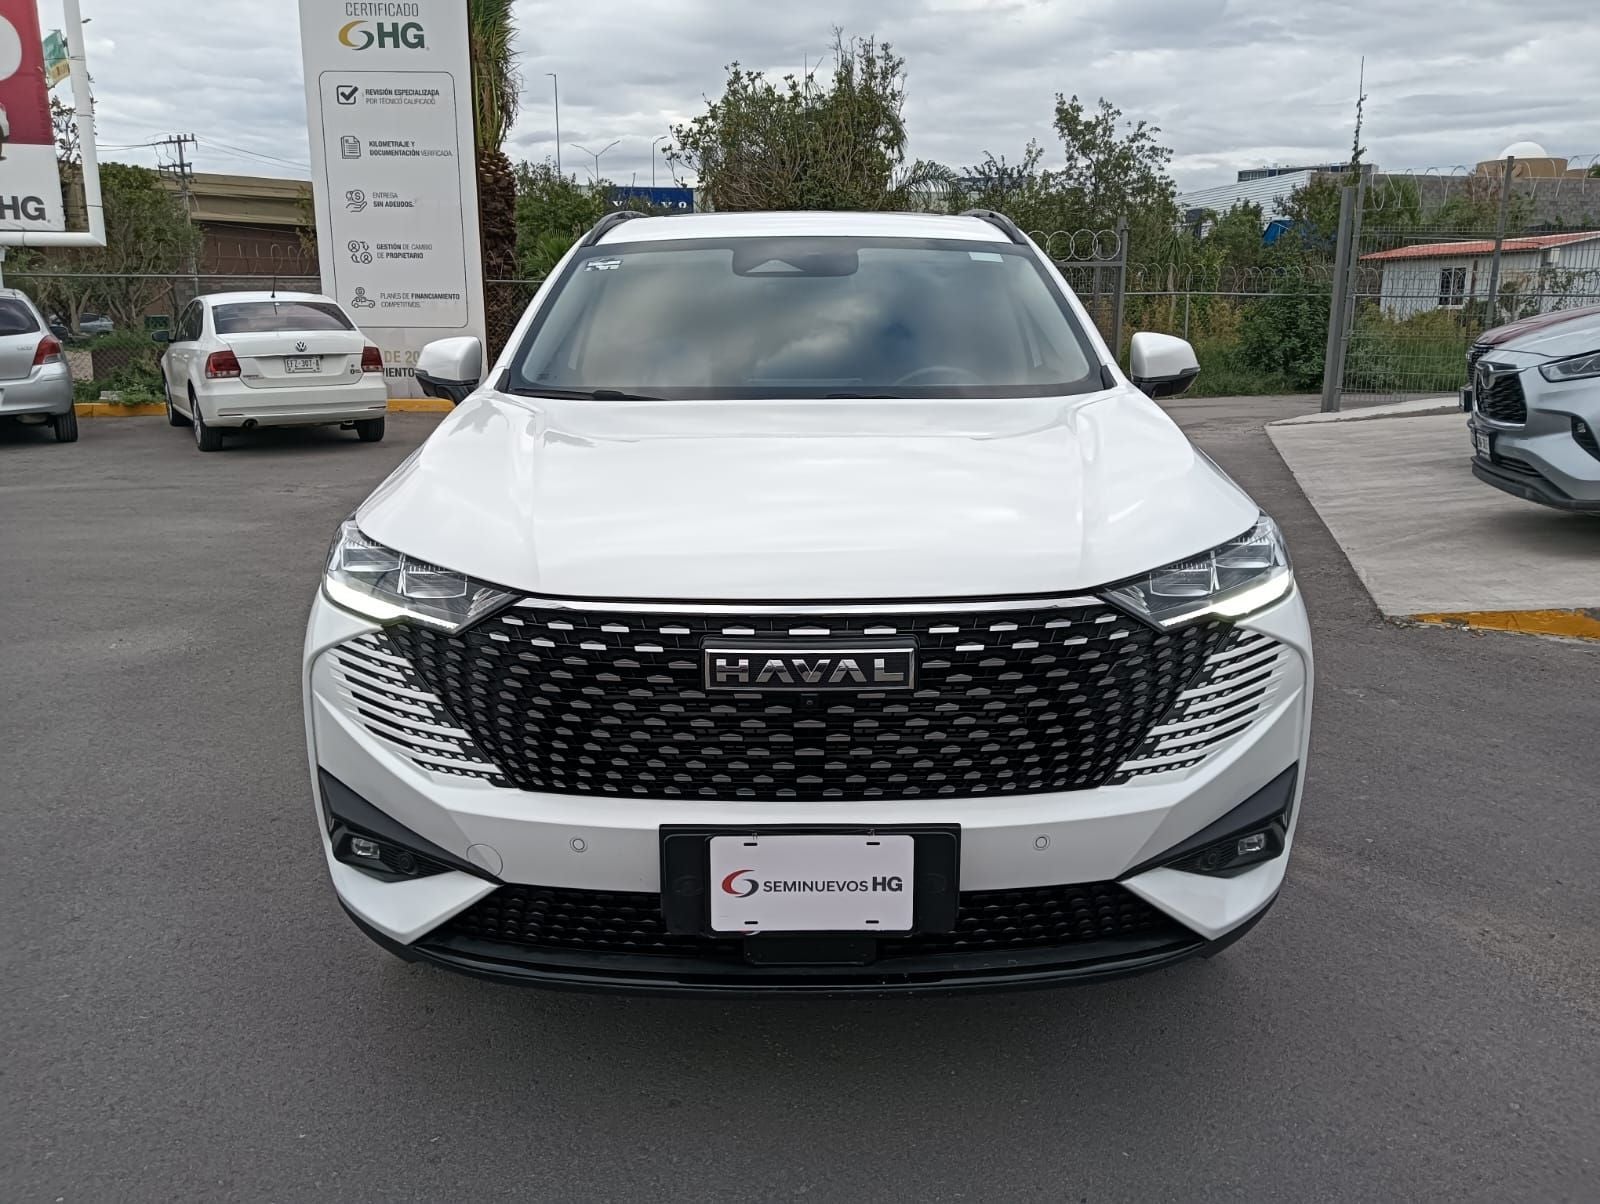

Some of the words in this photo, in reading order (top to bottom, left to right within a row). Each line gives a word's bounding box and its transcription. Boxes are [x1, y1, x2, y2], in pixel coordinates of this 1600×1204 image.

[345, 2, 419, 17] CERTIFICADO
[376, 21, 425, 49] HG
[365, 88, 393, 96] REVISIÓN
[368, 140, 410, 148] KILOMETRAJE
[369, 148, 420, 156] DOCUMENTACIÓN
[0, 195, 46, 221] HG
[373, 200, 384, 208] SIN
[380, 292, 401, 300] PLANES
[384, 350, 401, 363] DE
[383, 367, 415, 378] IENTO
[715, 658, 905, 684] HAVAL
[762, 879, 869, 893] SEMINUEVOS
[871, 875, 904, 893] HG
